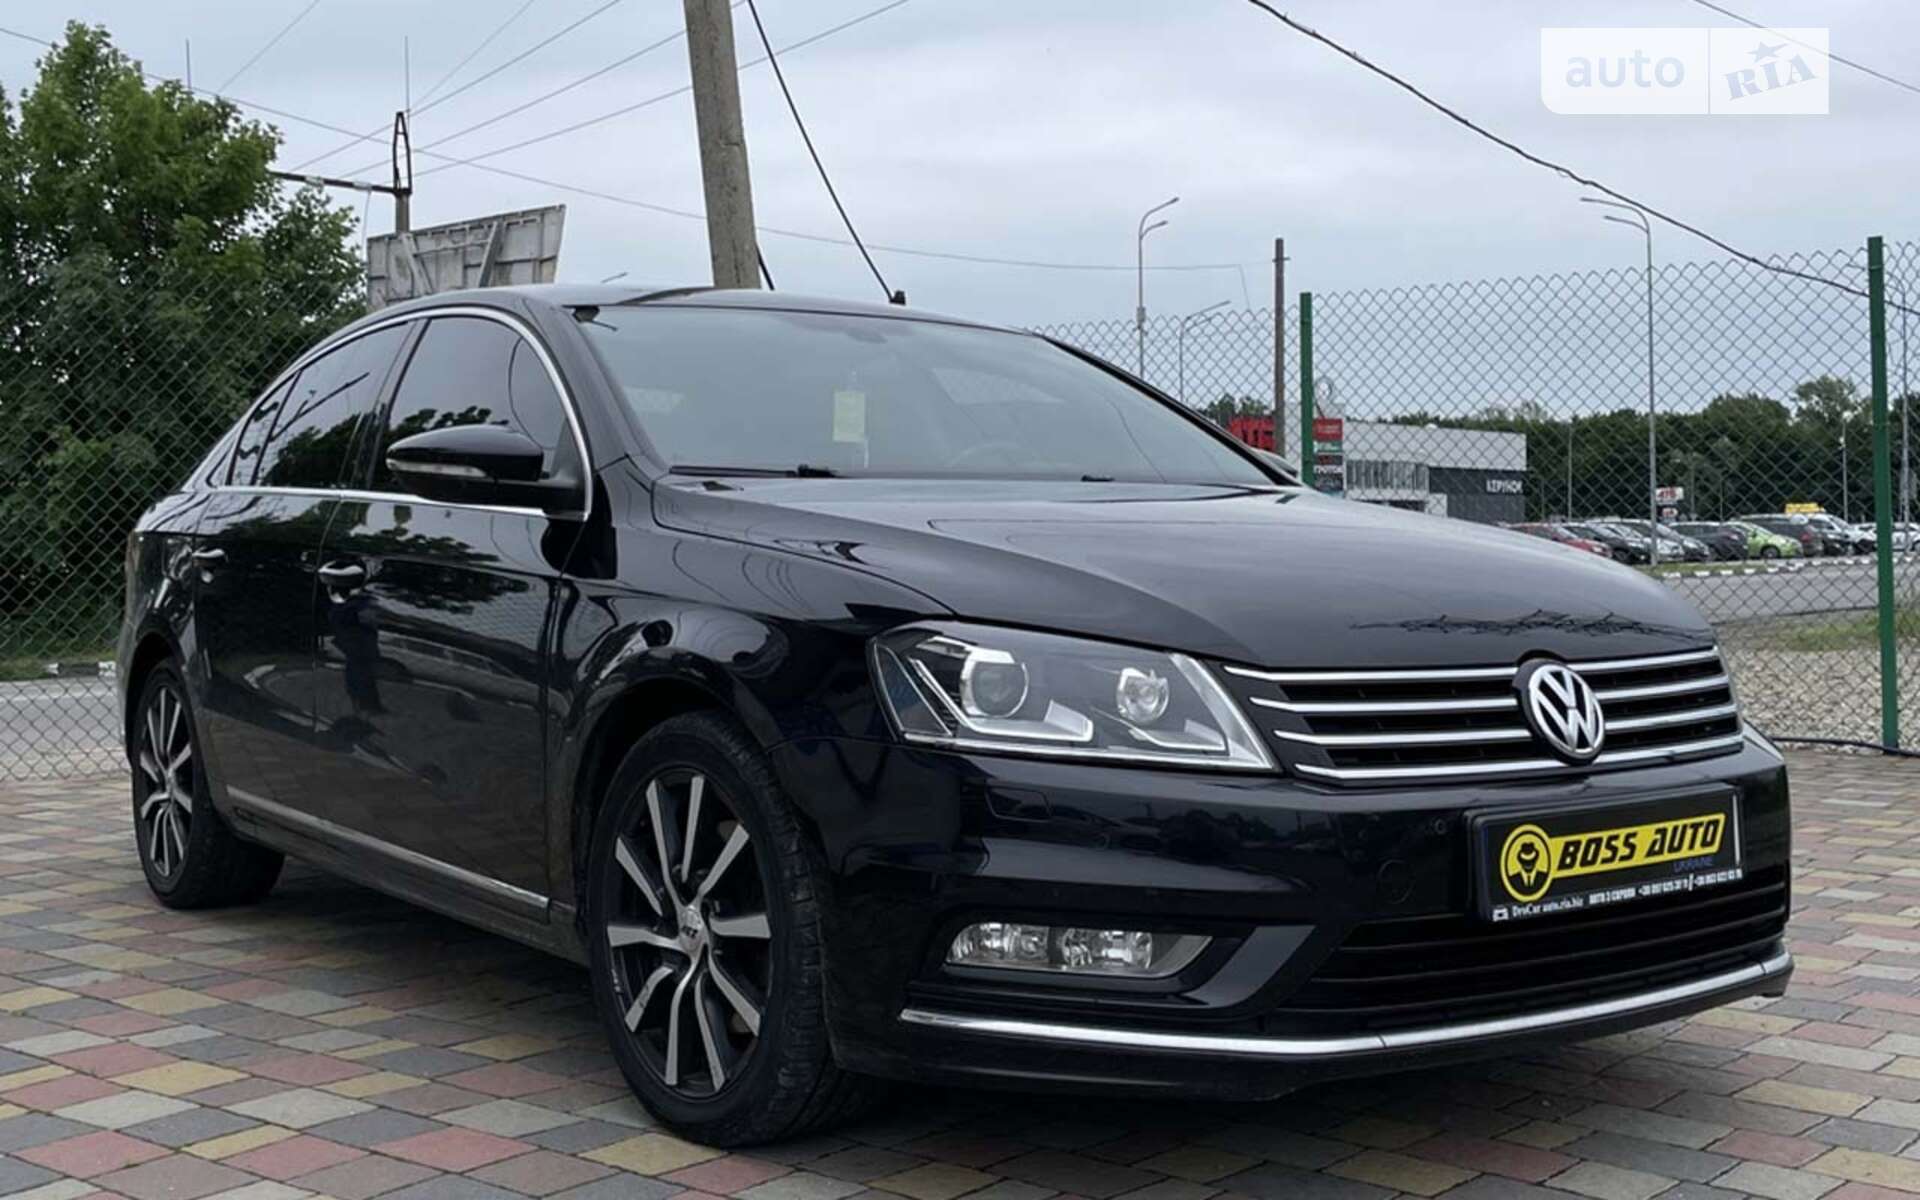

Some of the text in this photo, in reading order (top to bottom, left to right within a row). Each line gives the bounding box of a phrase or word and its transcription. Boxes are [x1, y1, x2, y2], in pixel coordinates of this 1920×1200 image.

[1528, 664, 1604, 755] VW
[1557, 818, 1721, 871] BOSS AUTO
